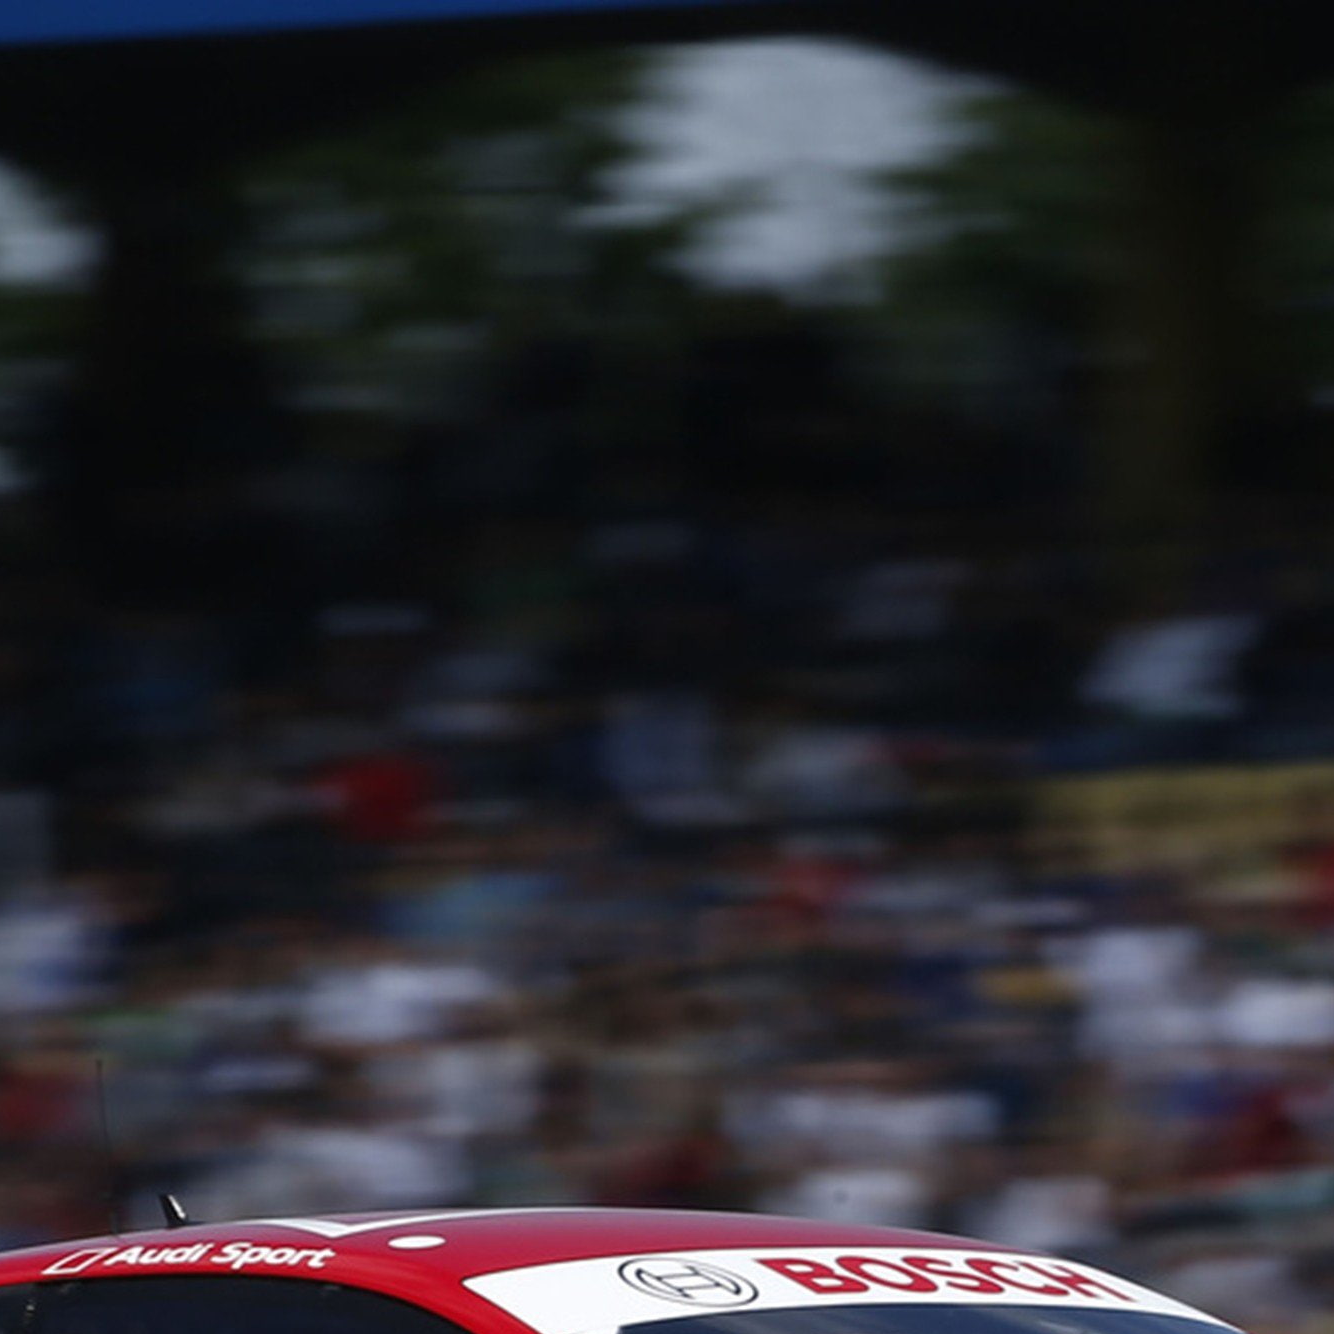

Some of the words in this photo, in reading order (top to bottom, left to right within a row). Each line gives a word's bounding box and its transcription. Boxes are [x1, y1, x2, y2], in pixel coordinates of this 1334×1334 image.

[103, 1243, 215, 1266] Audi
[210, 1242, 336, 1270] Sport
[753, 1255, 1137, 1302] BOSCH
